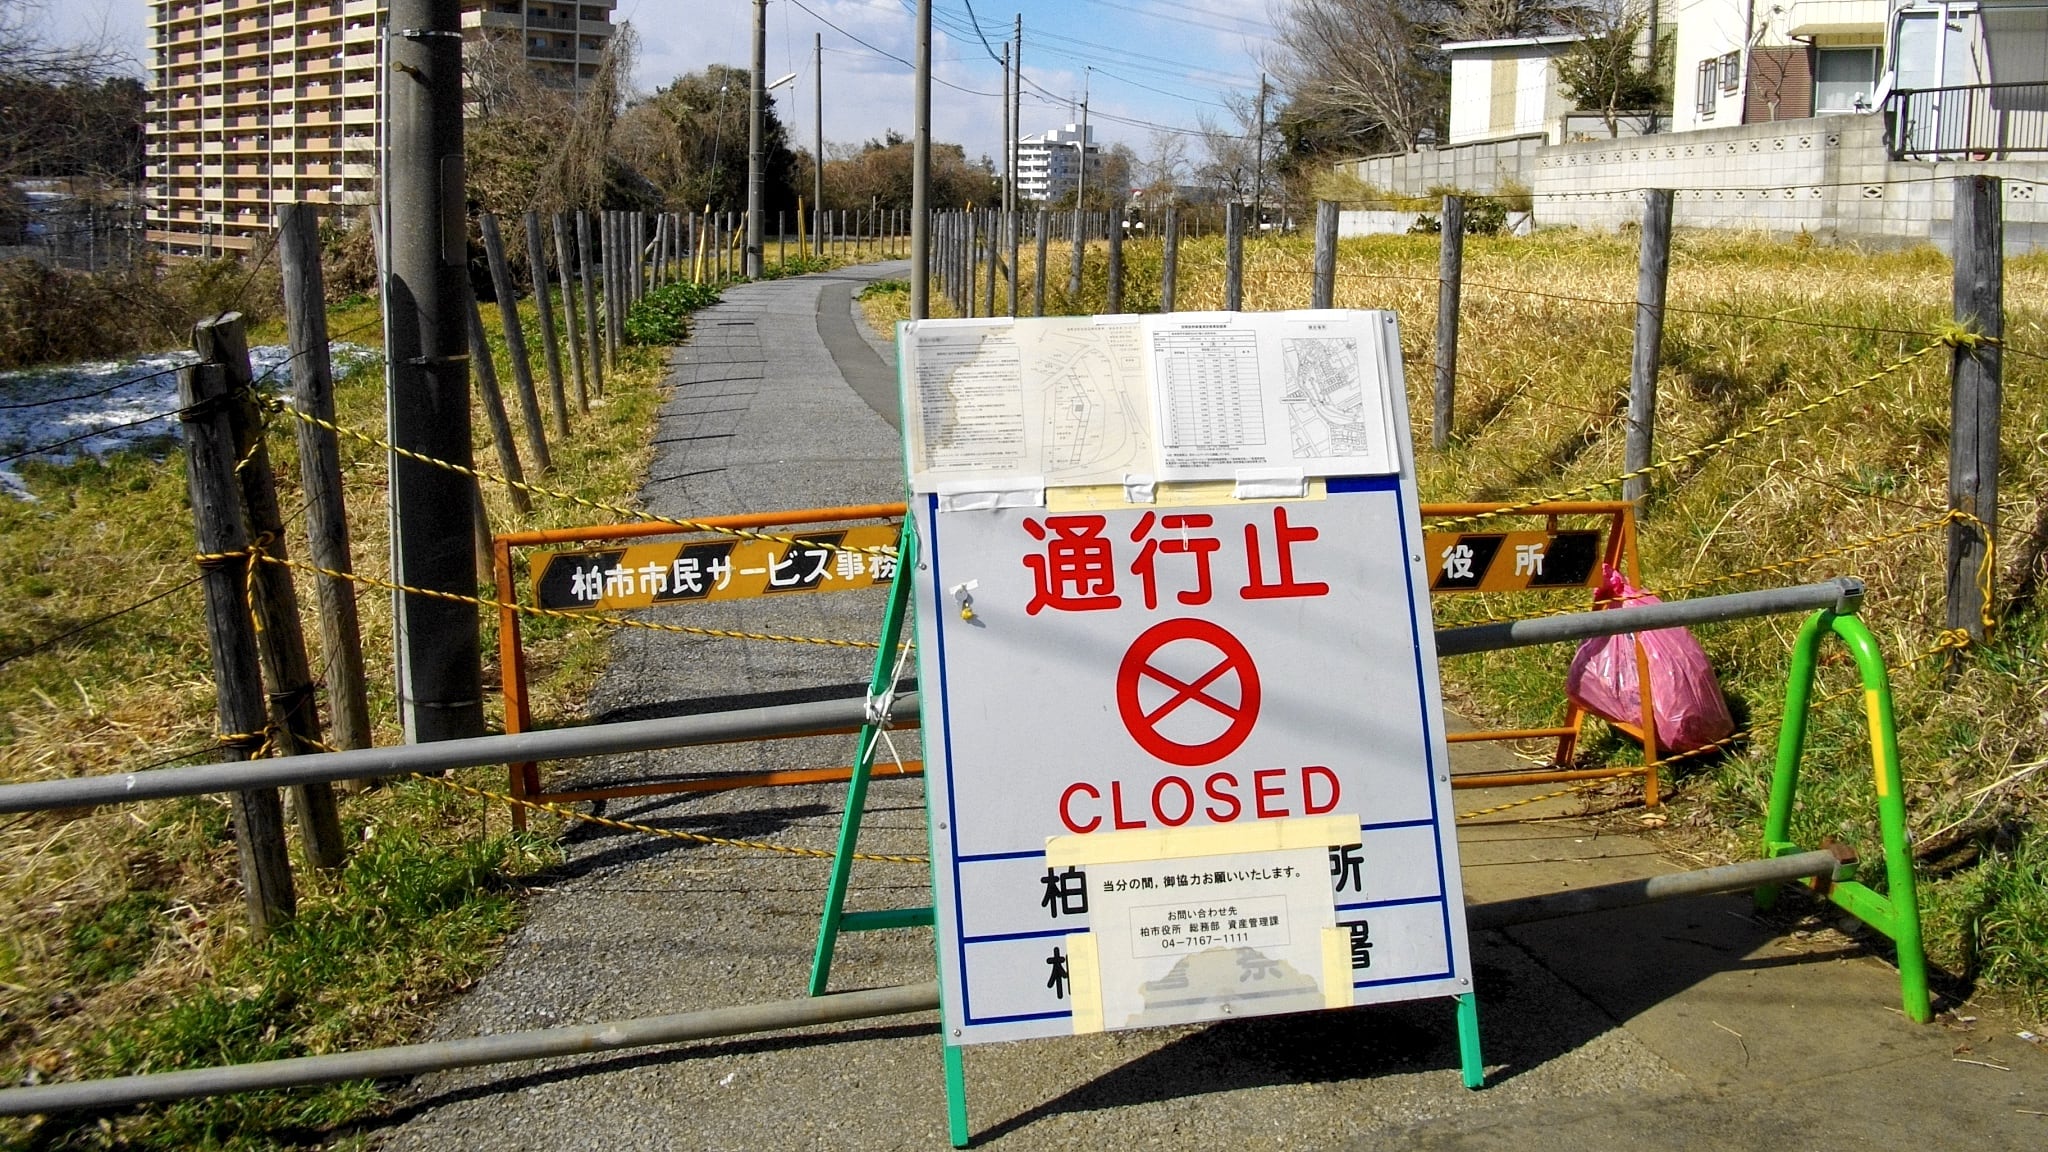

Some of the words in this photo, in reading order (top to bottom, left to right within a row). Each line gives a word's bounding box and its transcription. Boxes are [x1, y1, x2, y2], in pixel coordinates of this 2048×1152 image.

[571, 544, 898, 601] 柏市市民サービス事務
[1022, 506, 1330, 615] 通行止
[1059, 766, 1341, 834] CLOSED
[1140, 924, 1182, 938] 柏市役所
[1167, 906, 1238, 921] お問い合わせ先
